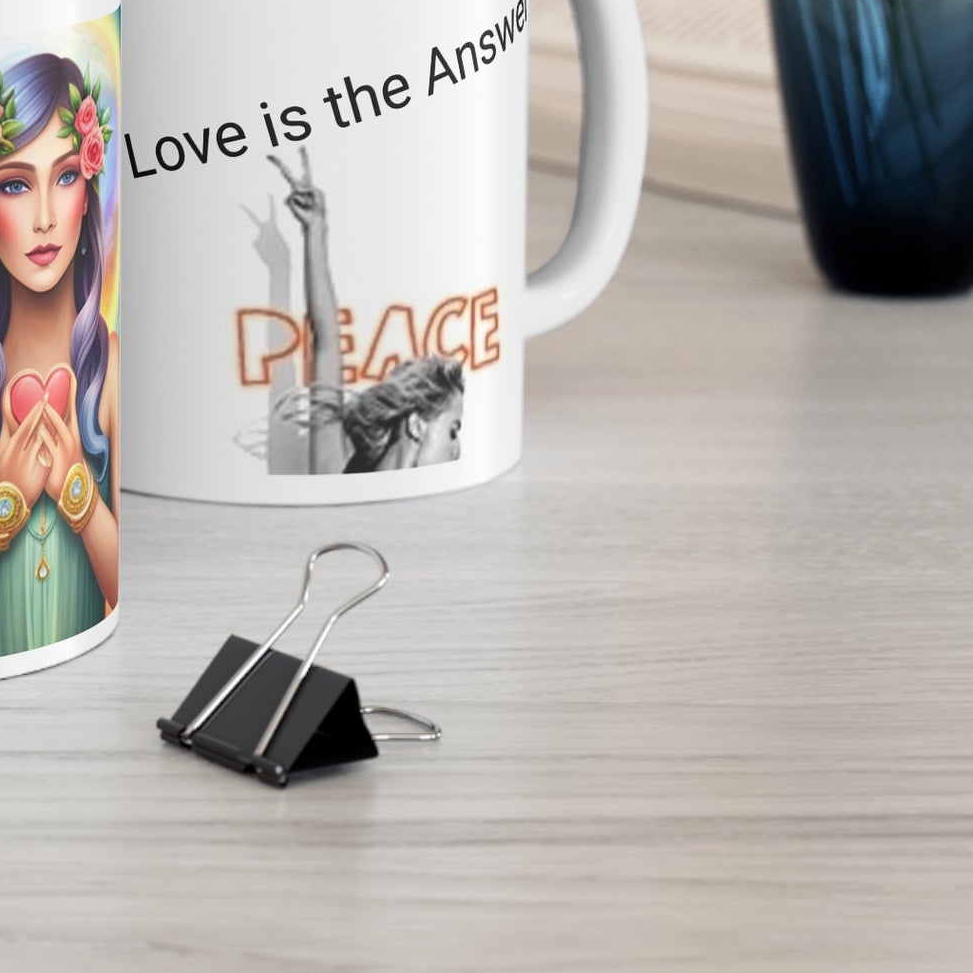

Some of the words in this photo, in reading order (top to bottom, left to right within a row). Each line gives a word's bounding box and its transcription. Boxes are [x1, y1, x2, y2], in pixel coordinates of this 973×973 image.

[123, 122, 248, 179] Love
[259, 101, 312, 148] is
[322, 75, 411, 128] the
